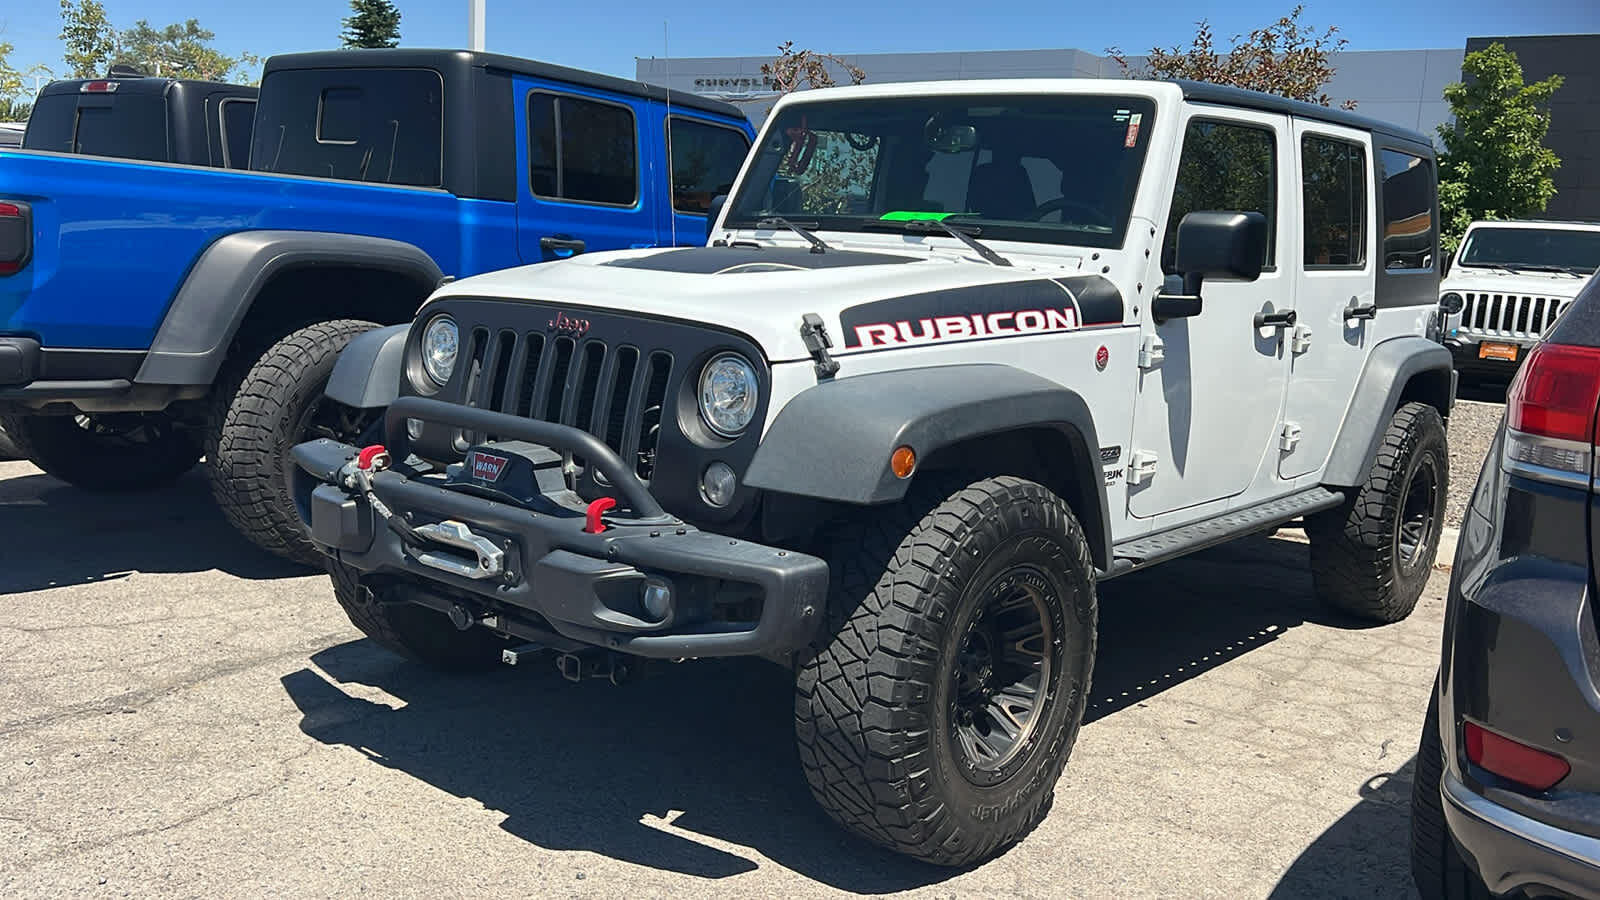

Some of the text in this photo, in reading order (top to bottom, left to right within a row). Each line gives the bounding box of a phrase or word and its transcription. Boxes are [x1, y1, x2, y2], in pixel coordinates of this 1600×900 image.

[694, 78, 780, 88] CHRYSLE
[547, 311, 590, 338] Jeep
[850, 307, 1075, 348] RUBICON
[476, 461, 499, 474] WARN
